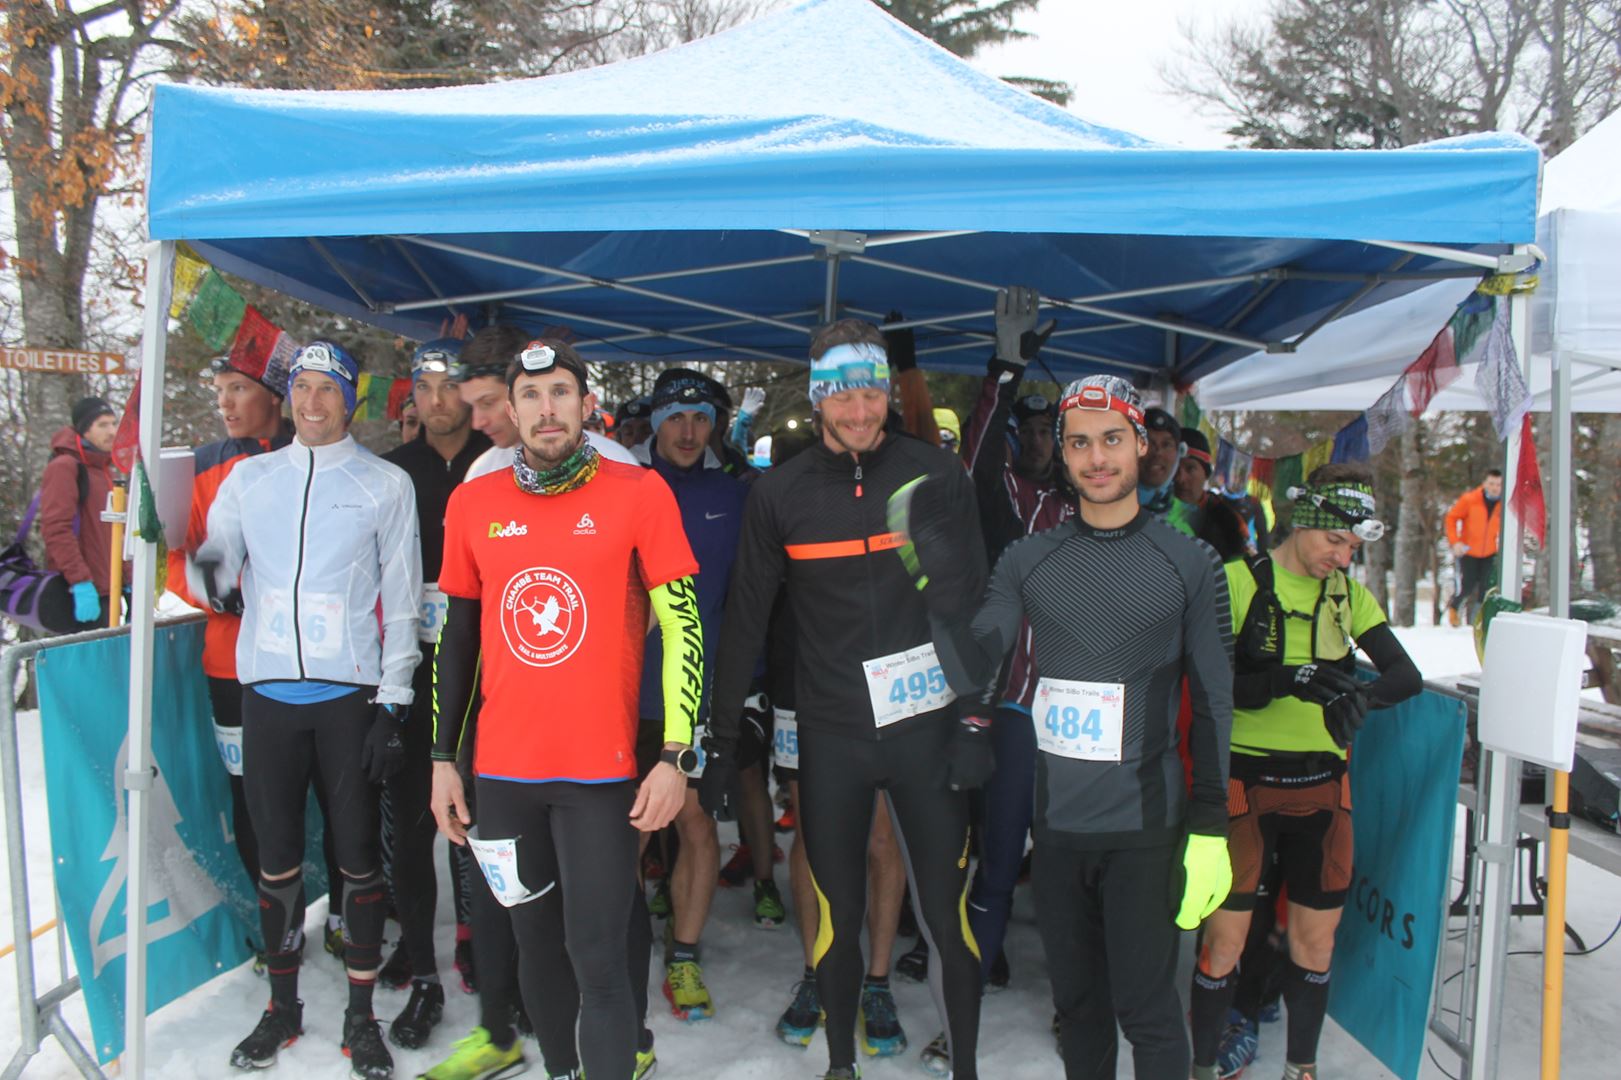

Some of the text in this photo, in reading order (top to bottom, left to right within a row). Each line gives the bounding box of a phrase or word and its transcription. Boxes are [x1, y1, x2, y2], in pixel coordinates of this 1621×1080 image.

[4, 349, 100, 372] TOILETTES
[506, 573, 580, 611] CHAMBÉ TEAM TRAIL
[889, 665, 946, 704] 495
[1045, 704, 1103, 742] 484
